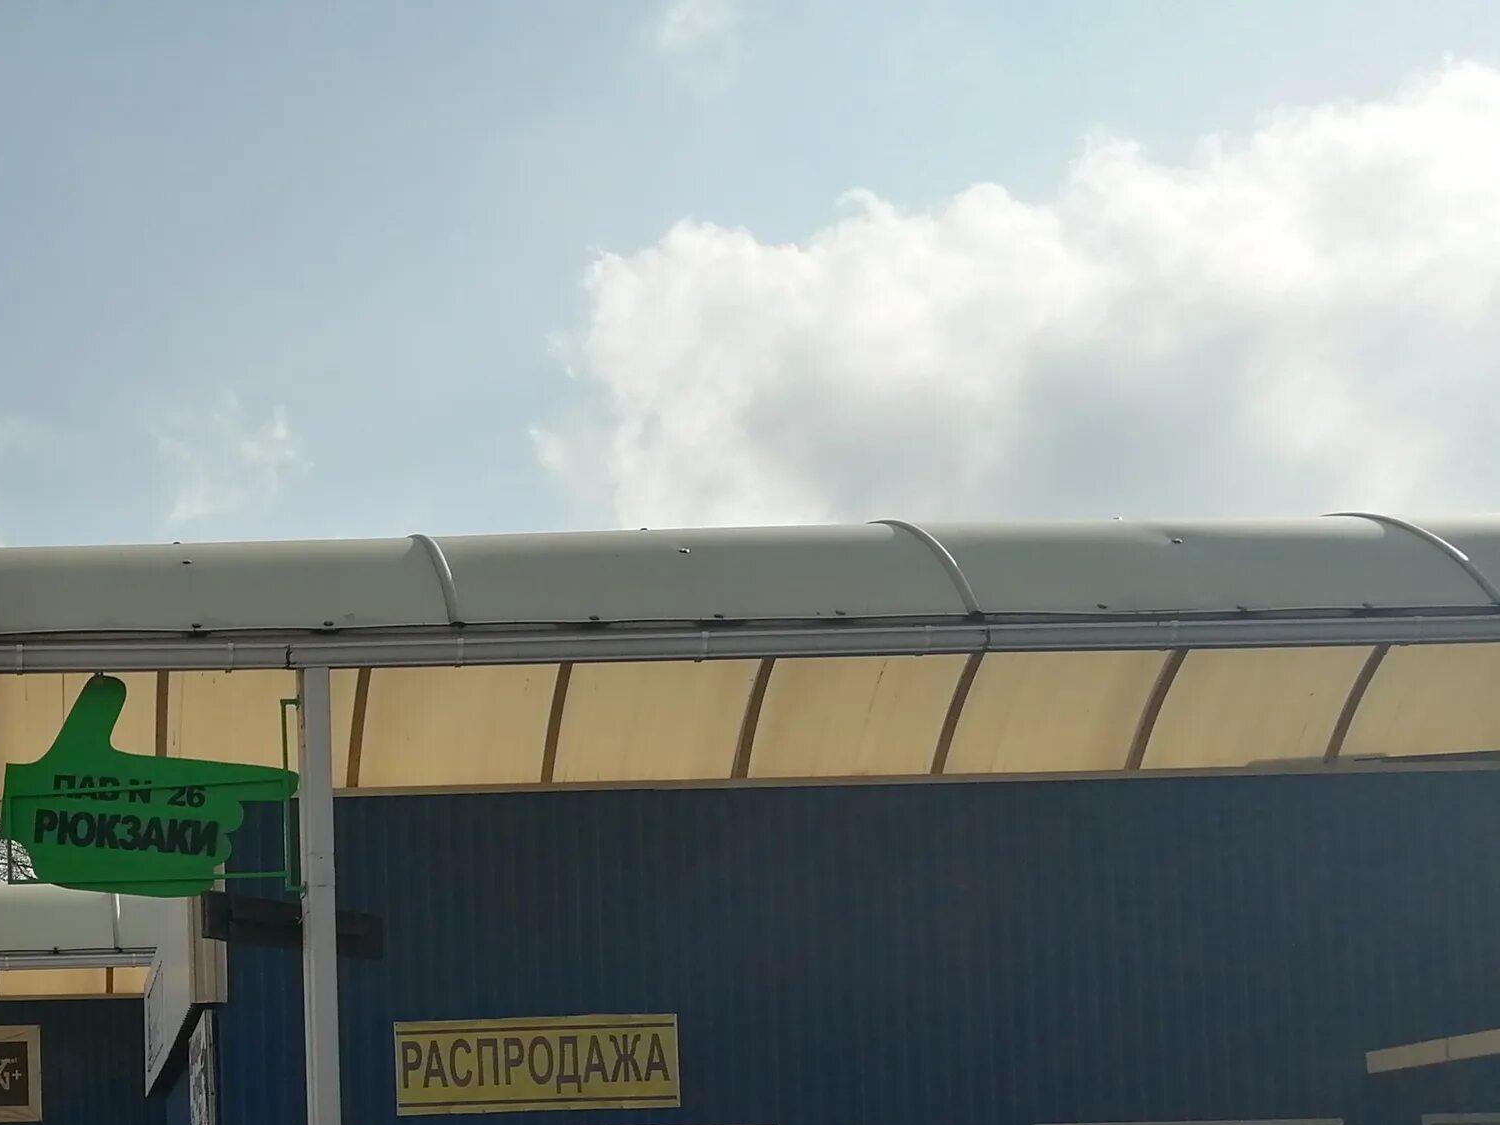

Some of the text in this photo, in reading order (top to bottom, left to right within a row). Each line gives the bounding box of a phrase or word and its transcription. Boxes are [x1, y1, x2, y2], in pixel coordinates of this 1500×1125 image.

[167, 785, 206, 808] 26
[33, 808, 220, 857] РЮКЗАКИ
[401, 1033, 671, 1094] РАСПРОДАЖА
